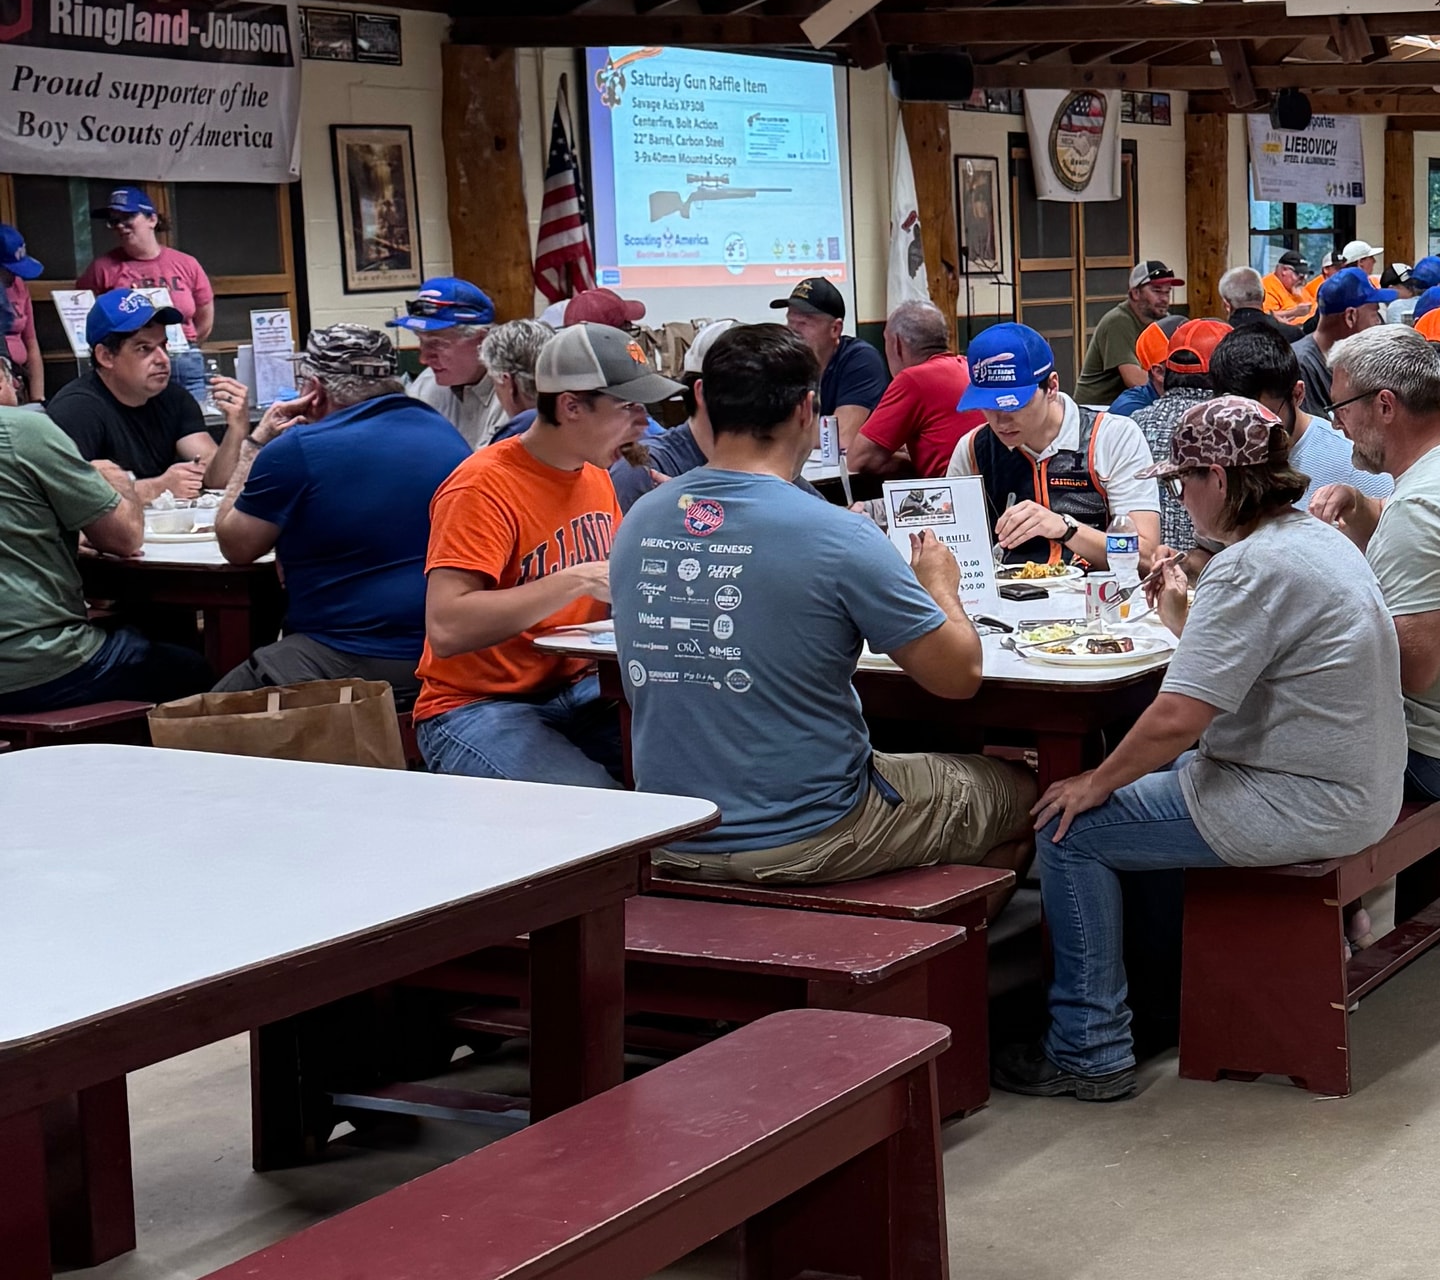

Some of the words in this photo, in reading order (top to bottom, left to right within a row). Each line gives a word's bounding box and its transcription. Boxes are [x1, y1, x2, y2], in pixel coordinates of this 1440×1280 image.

[11, 65, 103, 98] Proud
[109, 80, 216, 110] supporter
[220, 81, 243, 113] of
[241, 81, 269, 108] the
[630, 69, 681, 93] Saturday
[683, 73, 707, 90] Gun
[709, 75, 741, 92] Raffle
[743, 78, 768, 94] Item
[632, 97, 661, 113] Savage
[662, 99, 679, 111] Axis
[632, 114, 675, 129] Centerfire,
[676, 116, 692, 129] Bolt
[693, 117, 719, 130] Action
[16, 110, 69, 147] Boy
[77, 115, 165, 146] Scouts
[169, 122, 194, 153] of
[190, 122, 274, 149] America
[648, 134, 675, 147] Barrel,
[675, 134, 704, 147] Carbon
[705, 136, 725, 148] Steel
[1284, 135, 1338, 156] LIEBOVICH
[678, 152, 713, 164] Mounted
[714, 153, 737, 167] Scope
[623, 233, 662, 248] Scouting
[674, 233, 709, 245] America
[641, 538, 703, 552] MERCYONE
[708, 544, 753, 555] GENESIS
[638, 612, 664, 625] Weber
